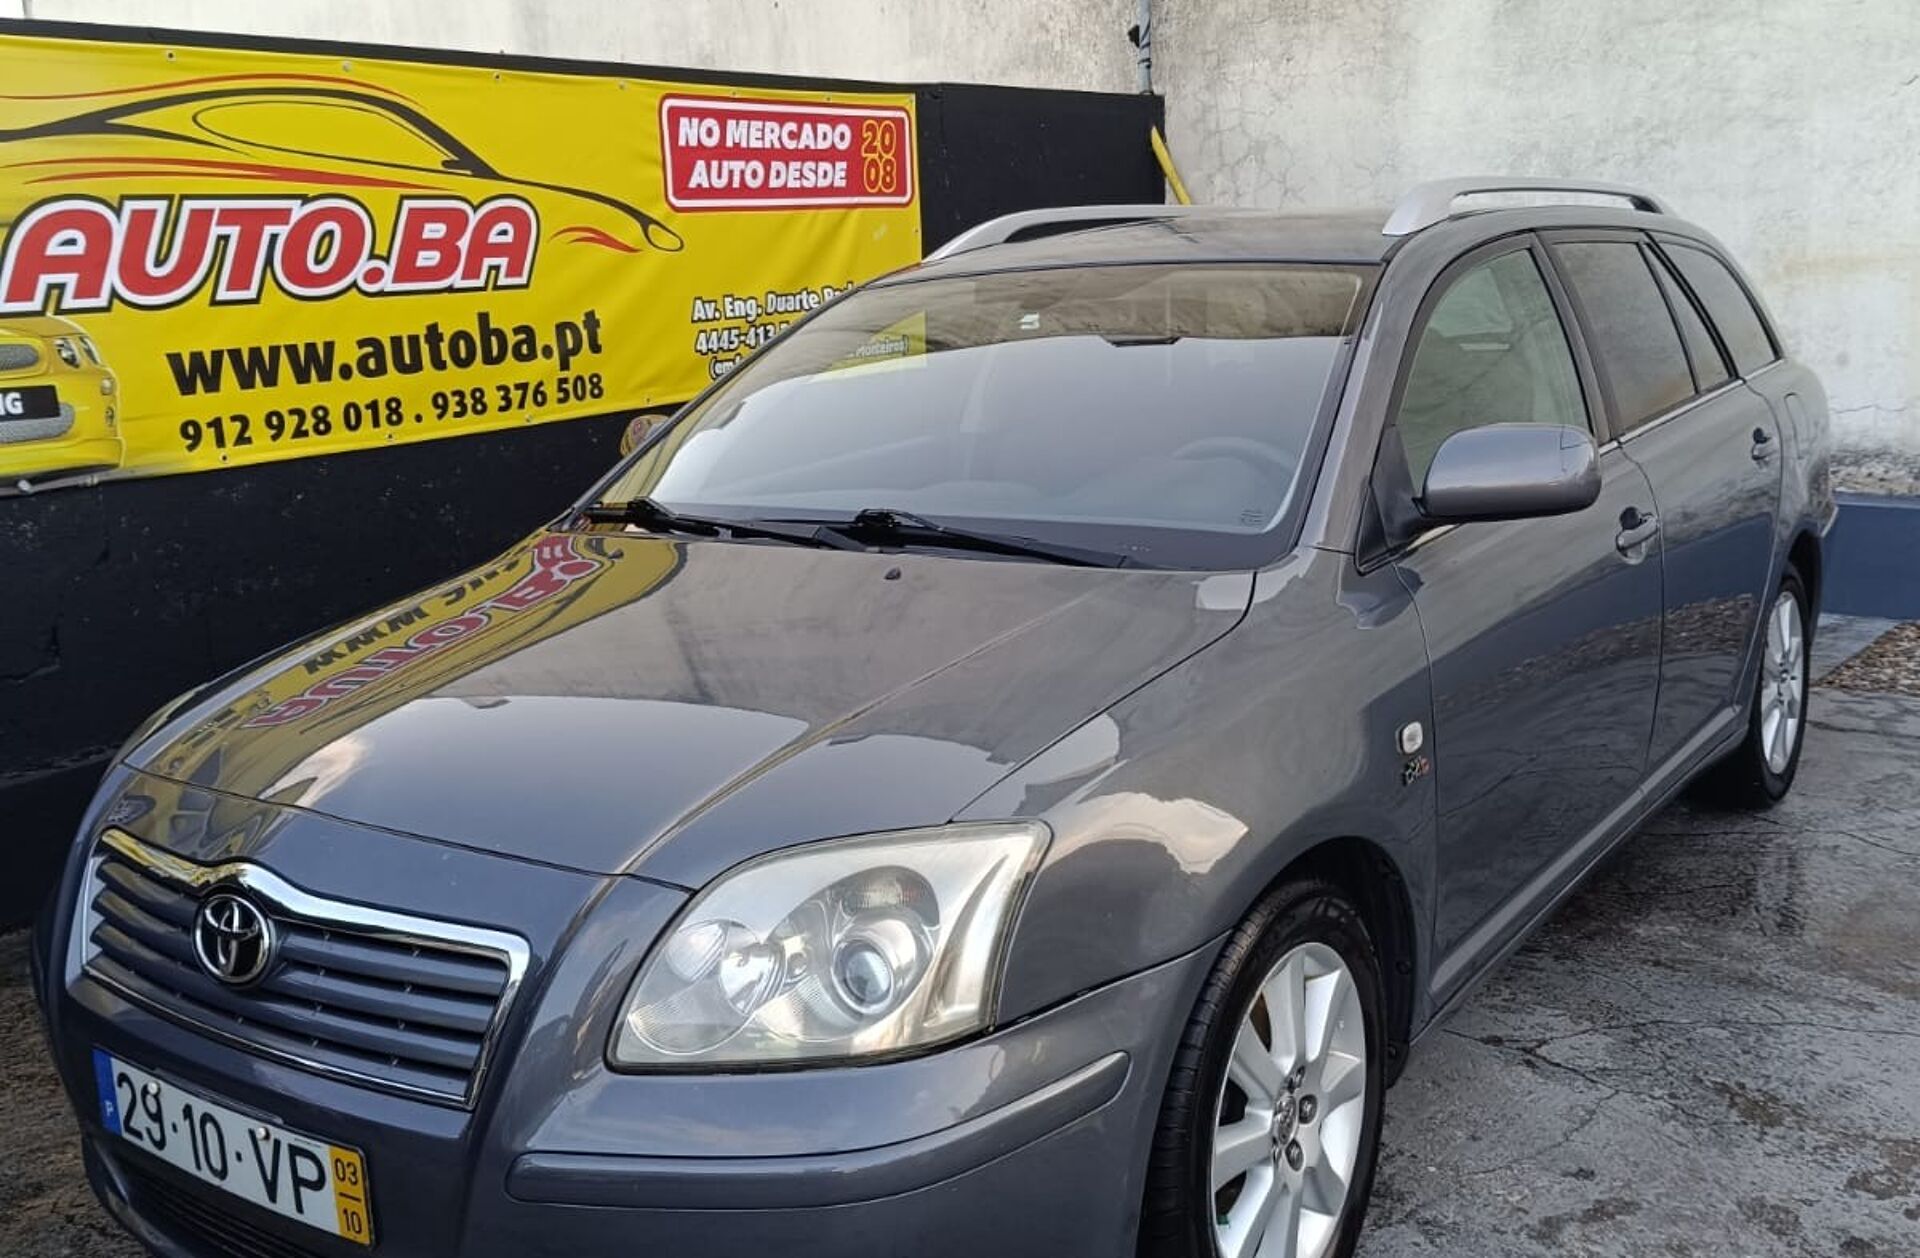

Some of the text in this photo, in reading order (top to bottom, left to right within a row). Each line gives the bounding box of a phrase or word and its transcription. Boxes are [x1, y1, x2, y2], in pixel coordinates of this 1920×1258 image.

[678, 116, 851, 151] NO MERCADO
[861, 119, 897, 157] 20
[688, 159, 847, 189] AUTO DESDE
[863, 155, 897, 193] 08
[1, 196, 539, 314] AUTO.BA
[692, 298, 721, 321] Av.
[724, 295, 763, 323] Eng.
[765, 289, 821, 315] Duarte
[166, 311, 602, 396] www.autoba.pt
[180, 414, 253, 452] 912
[264, 405, 332, 442] 928
[343, 397, 404, 432] 018
[431, 387, 488, 420] 938
[495, 380, 548, 413] 376
[557, 373, 604, 404] 508
[334, 1157, 359, 1187] 03
[342, 1207, 363, 1235] 10
